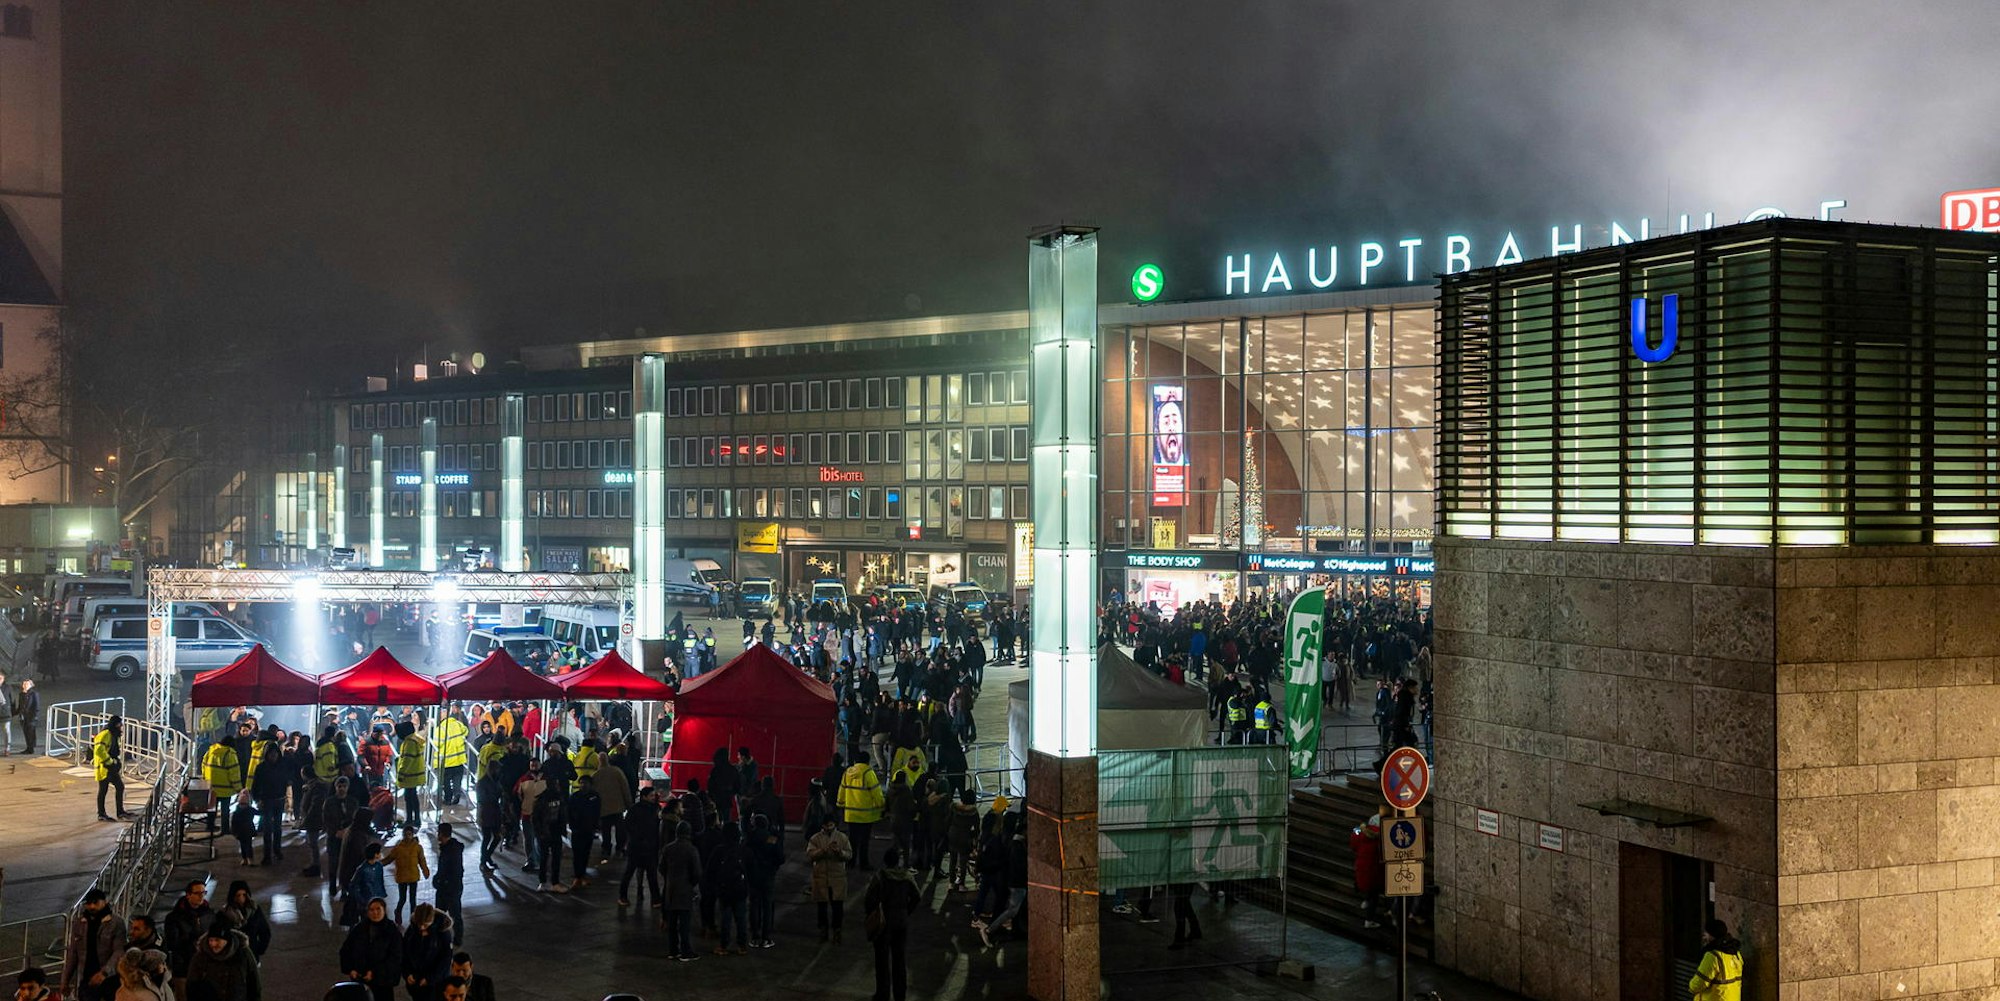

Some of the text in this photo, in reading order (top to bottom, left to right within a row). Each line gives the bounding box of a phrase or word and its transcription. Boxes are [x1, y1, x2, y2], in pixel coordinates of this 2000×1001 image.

[1951, 196, 2000, 231] DB
[1135, 266, 1160, 300] S
[1630, 293, 1679, 363] U
[440, 474, 469, 485] COFFEE
[604, 471, 626, 483] dean
[819, 466, 865, 482] ibis HOTEL
[977, 555, 1007, 568] CHAN
[1127, 555, 1201, 568] THE BODY SHOP
[1263, 558, 1316, 571] NetCologne
[1338, 559, 1388, 572] Highspeed
[1393, 849, 1415, 859] ZONE
